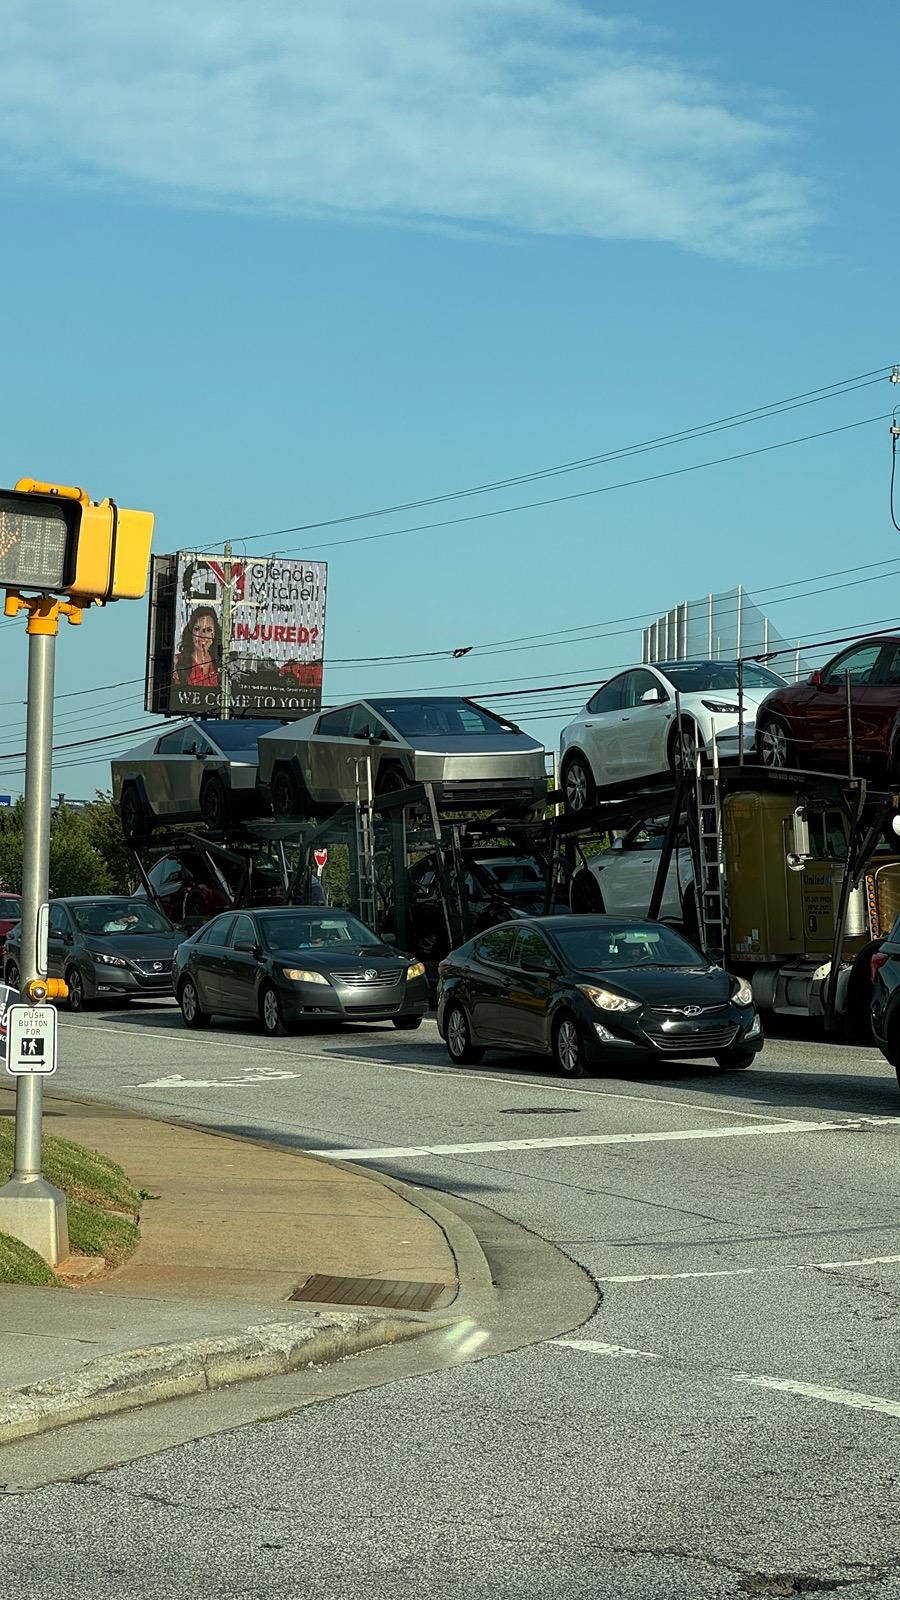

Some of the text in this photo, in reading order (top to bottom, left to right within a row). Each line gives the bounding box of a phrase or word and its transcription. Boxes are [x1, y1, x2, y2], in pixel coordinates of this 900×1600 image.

[252, 563, 314, 583] Glenda
[250, 582, 319, 601] Mitchell
[272, 603, 293, 612] FIRM
[231, 623, 319, 644] NJURED?
[178, 691, 201, 705] WE
[255, 695, 276, 708] TO
[280, 697, 316, 712] YOU!
